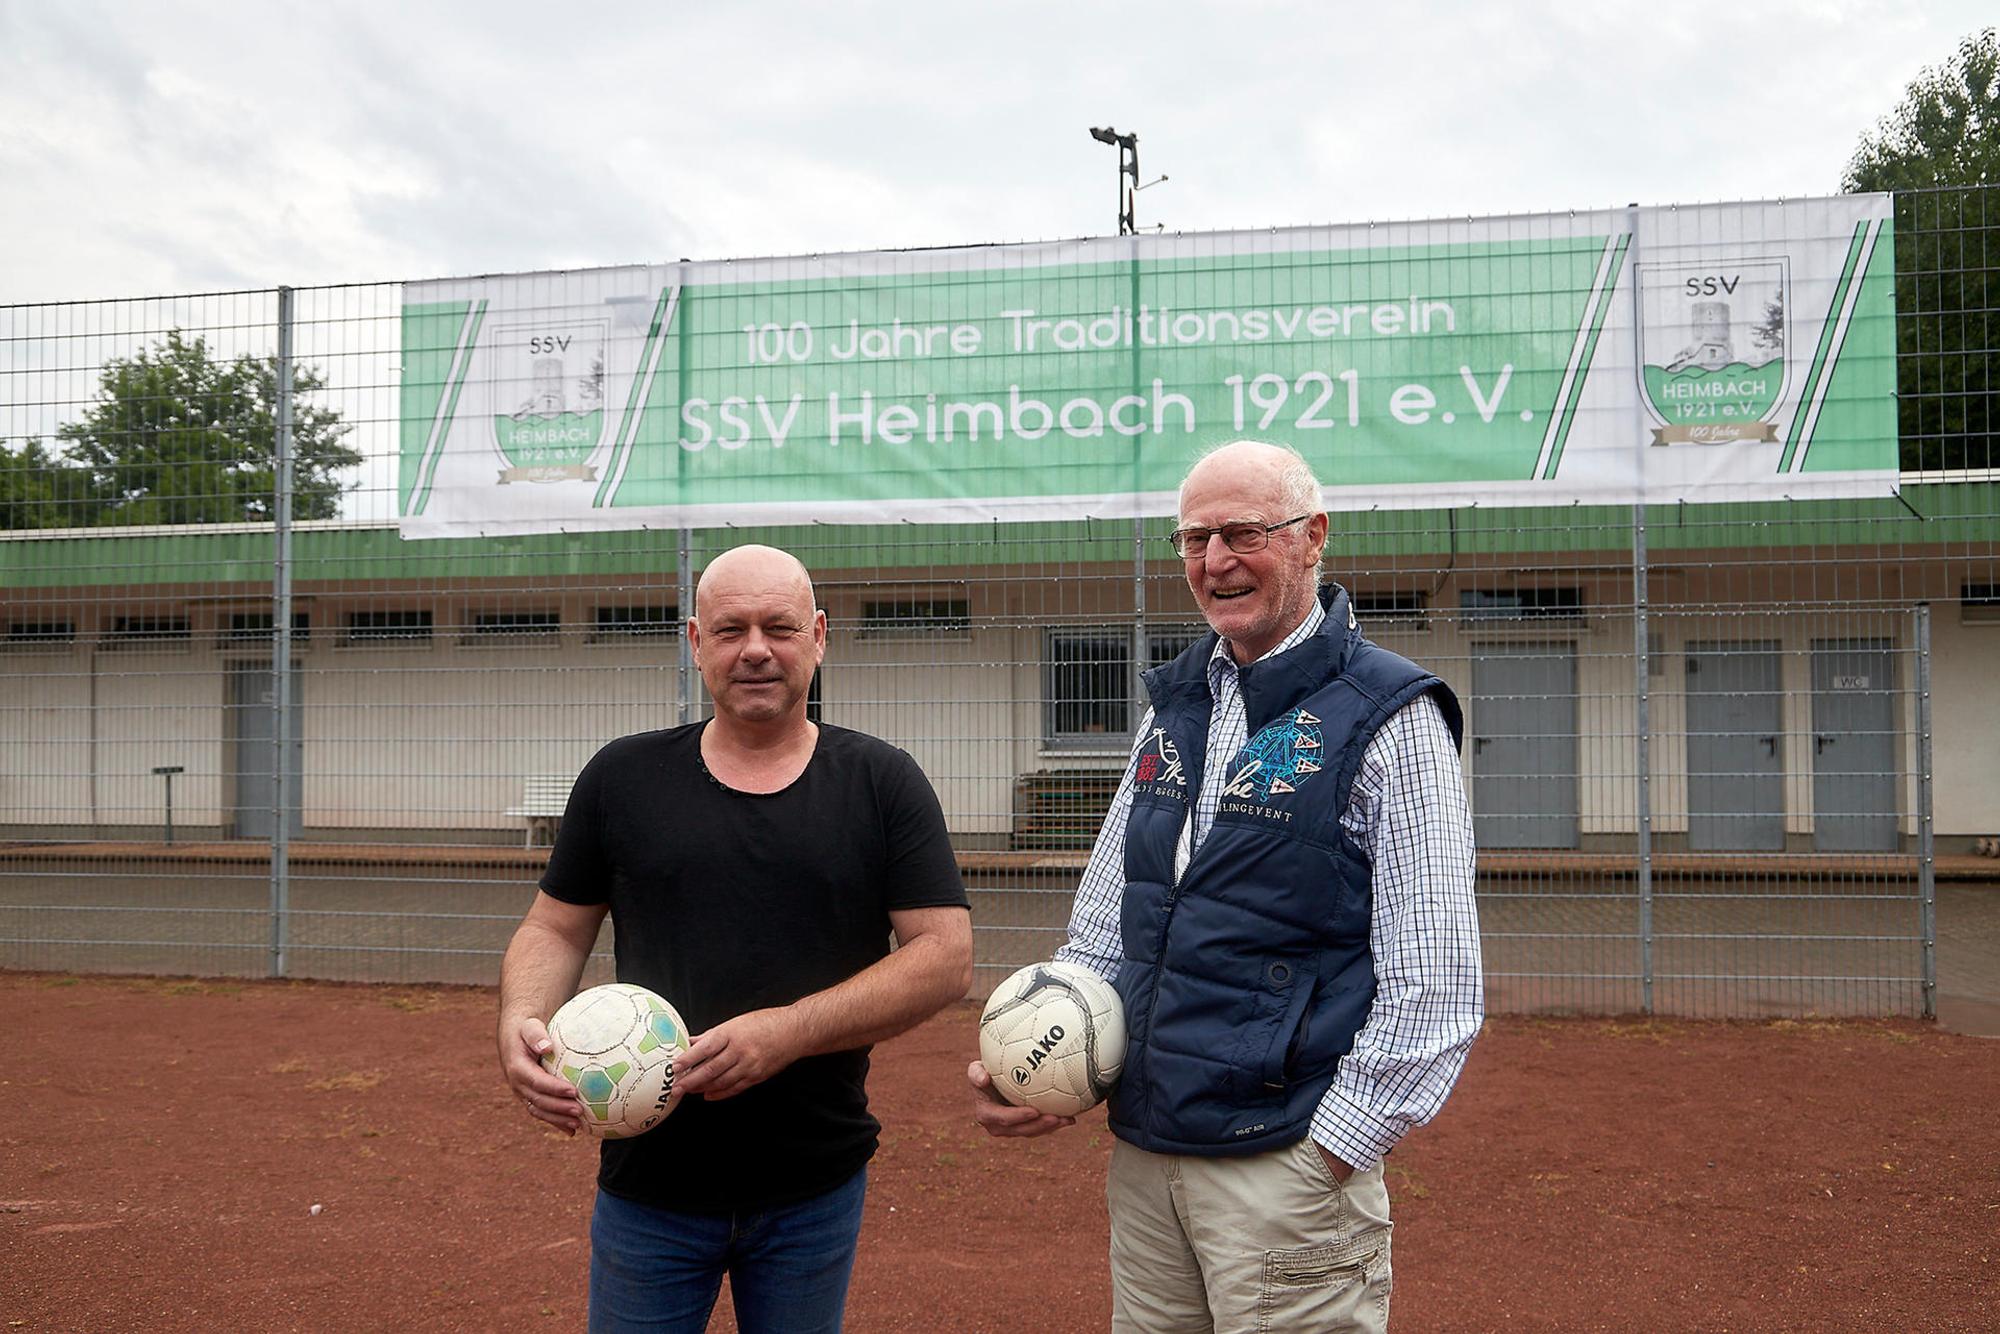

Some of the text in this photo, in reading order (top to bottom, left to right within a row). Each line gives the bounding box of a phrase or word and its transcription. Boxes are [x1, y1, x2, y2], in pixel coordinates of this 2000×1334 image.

[1685, 275, 1740, 297] SSV
[742, 295, 1456, 363] 100 Jahre Traditionsverein
[530, 335, 572, 355] SSV
[1662, 380, 1766, 399] HEIMBACH
[679, 364, 1533, 452] SSV Heimbach 1921 e.V.
[1675, 400, 1757, 418] 1921 e.V.
[508, 428, 590, 444] HEIMBACH
[1025, 1025, 1065, 1071] JAKO
[654, 1063, 675, 1111] JAKO
